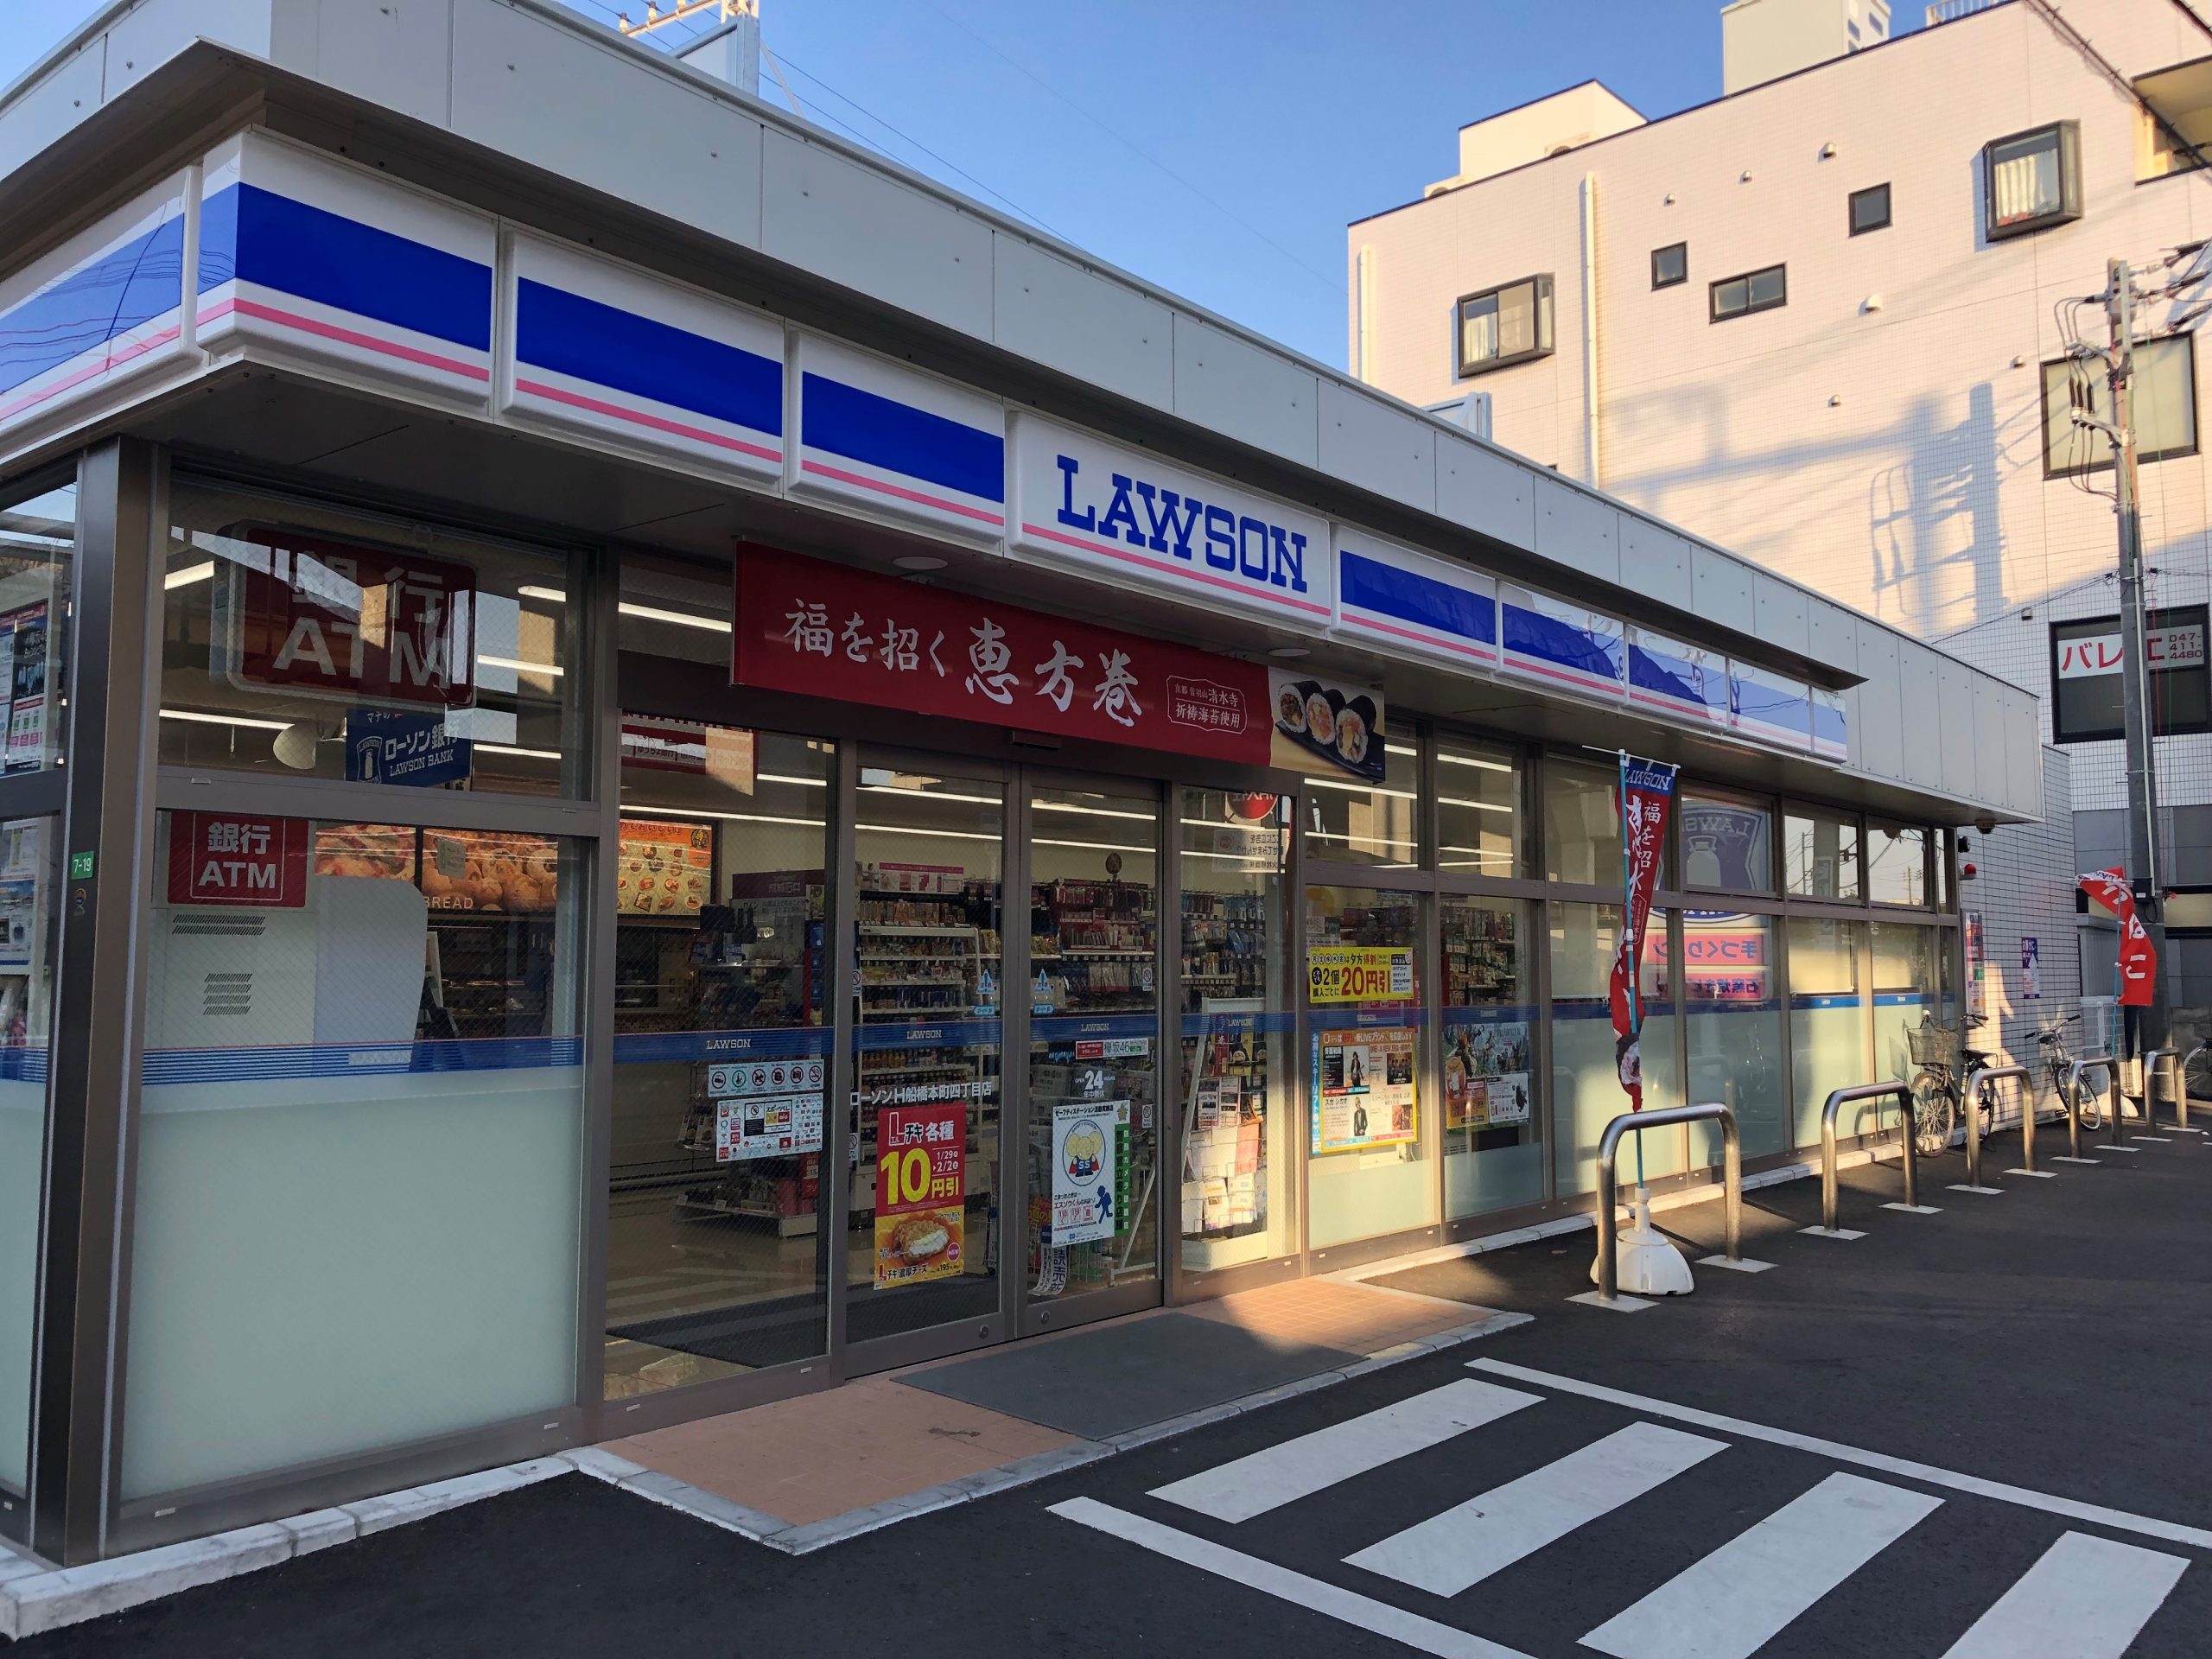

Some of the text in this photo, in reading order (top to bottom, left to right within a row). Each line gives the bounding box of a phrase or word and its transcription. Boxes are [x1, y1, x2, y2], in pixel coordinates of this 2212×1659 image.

[1057, 454, 1307, 594] LAWSON
[2170, 632, 2202, 643] 047-
[272, 616, 453, 690] ATM
[2170, 650, 2202, 660] 4480
[1176, 702, 1240, 728] 祈祷海苔使用
[389, 749, 454, 777] LAWSON BANK
[208, 821, 271, 855] 銀行
[73, 856, 92, 874] 7-19
[198, 861, 276, 890] ATM
[423, 895, 474, 909] BREAD
[1341, 966, 1391, 996] 20円引
[906, 1029, 942, 1040] LAWSON
[1080, 1022, 1109, 1032] LAWSON
[706, 1038, 752, 1050] LAWSON
[1084, 1070, 1104, 1090] 24
[850, 1082, 992, 1107] ローソンH船橋本町四丁目店
[880, 1147, 931, 1205] 10
[1078, 1160, 1090, 1171] SS
[931, 1176, 959, 1199] 円引
